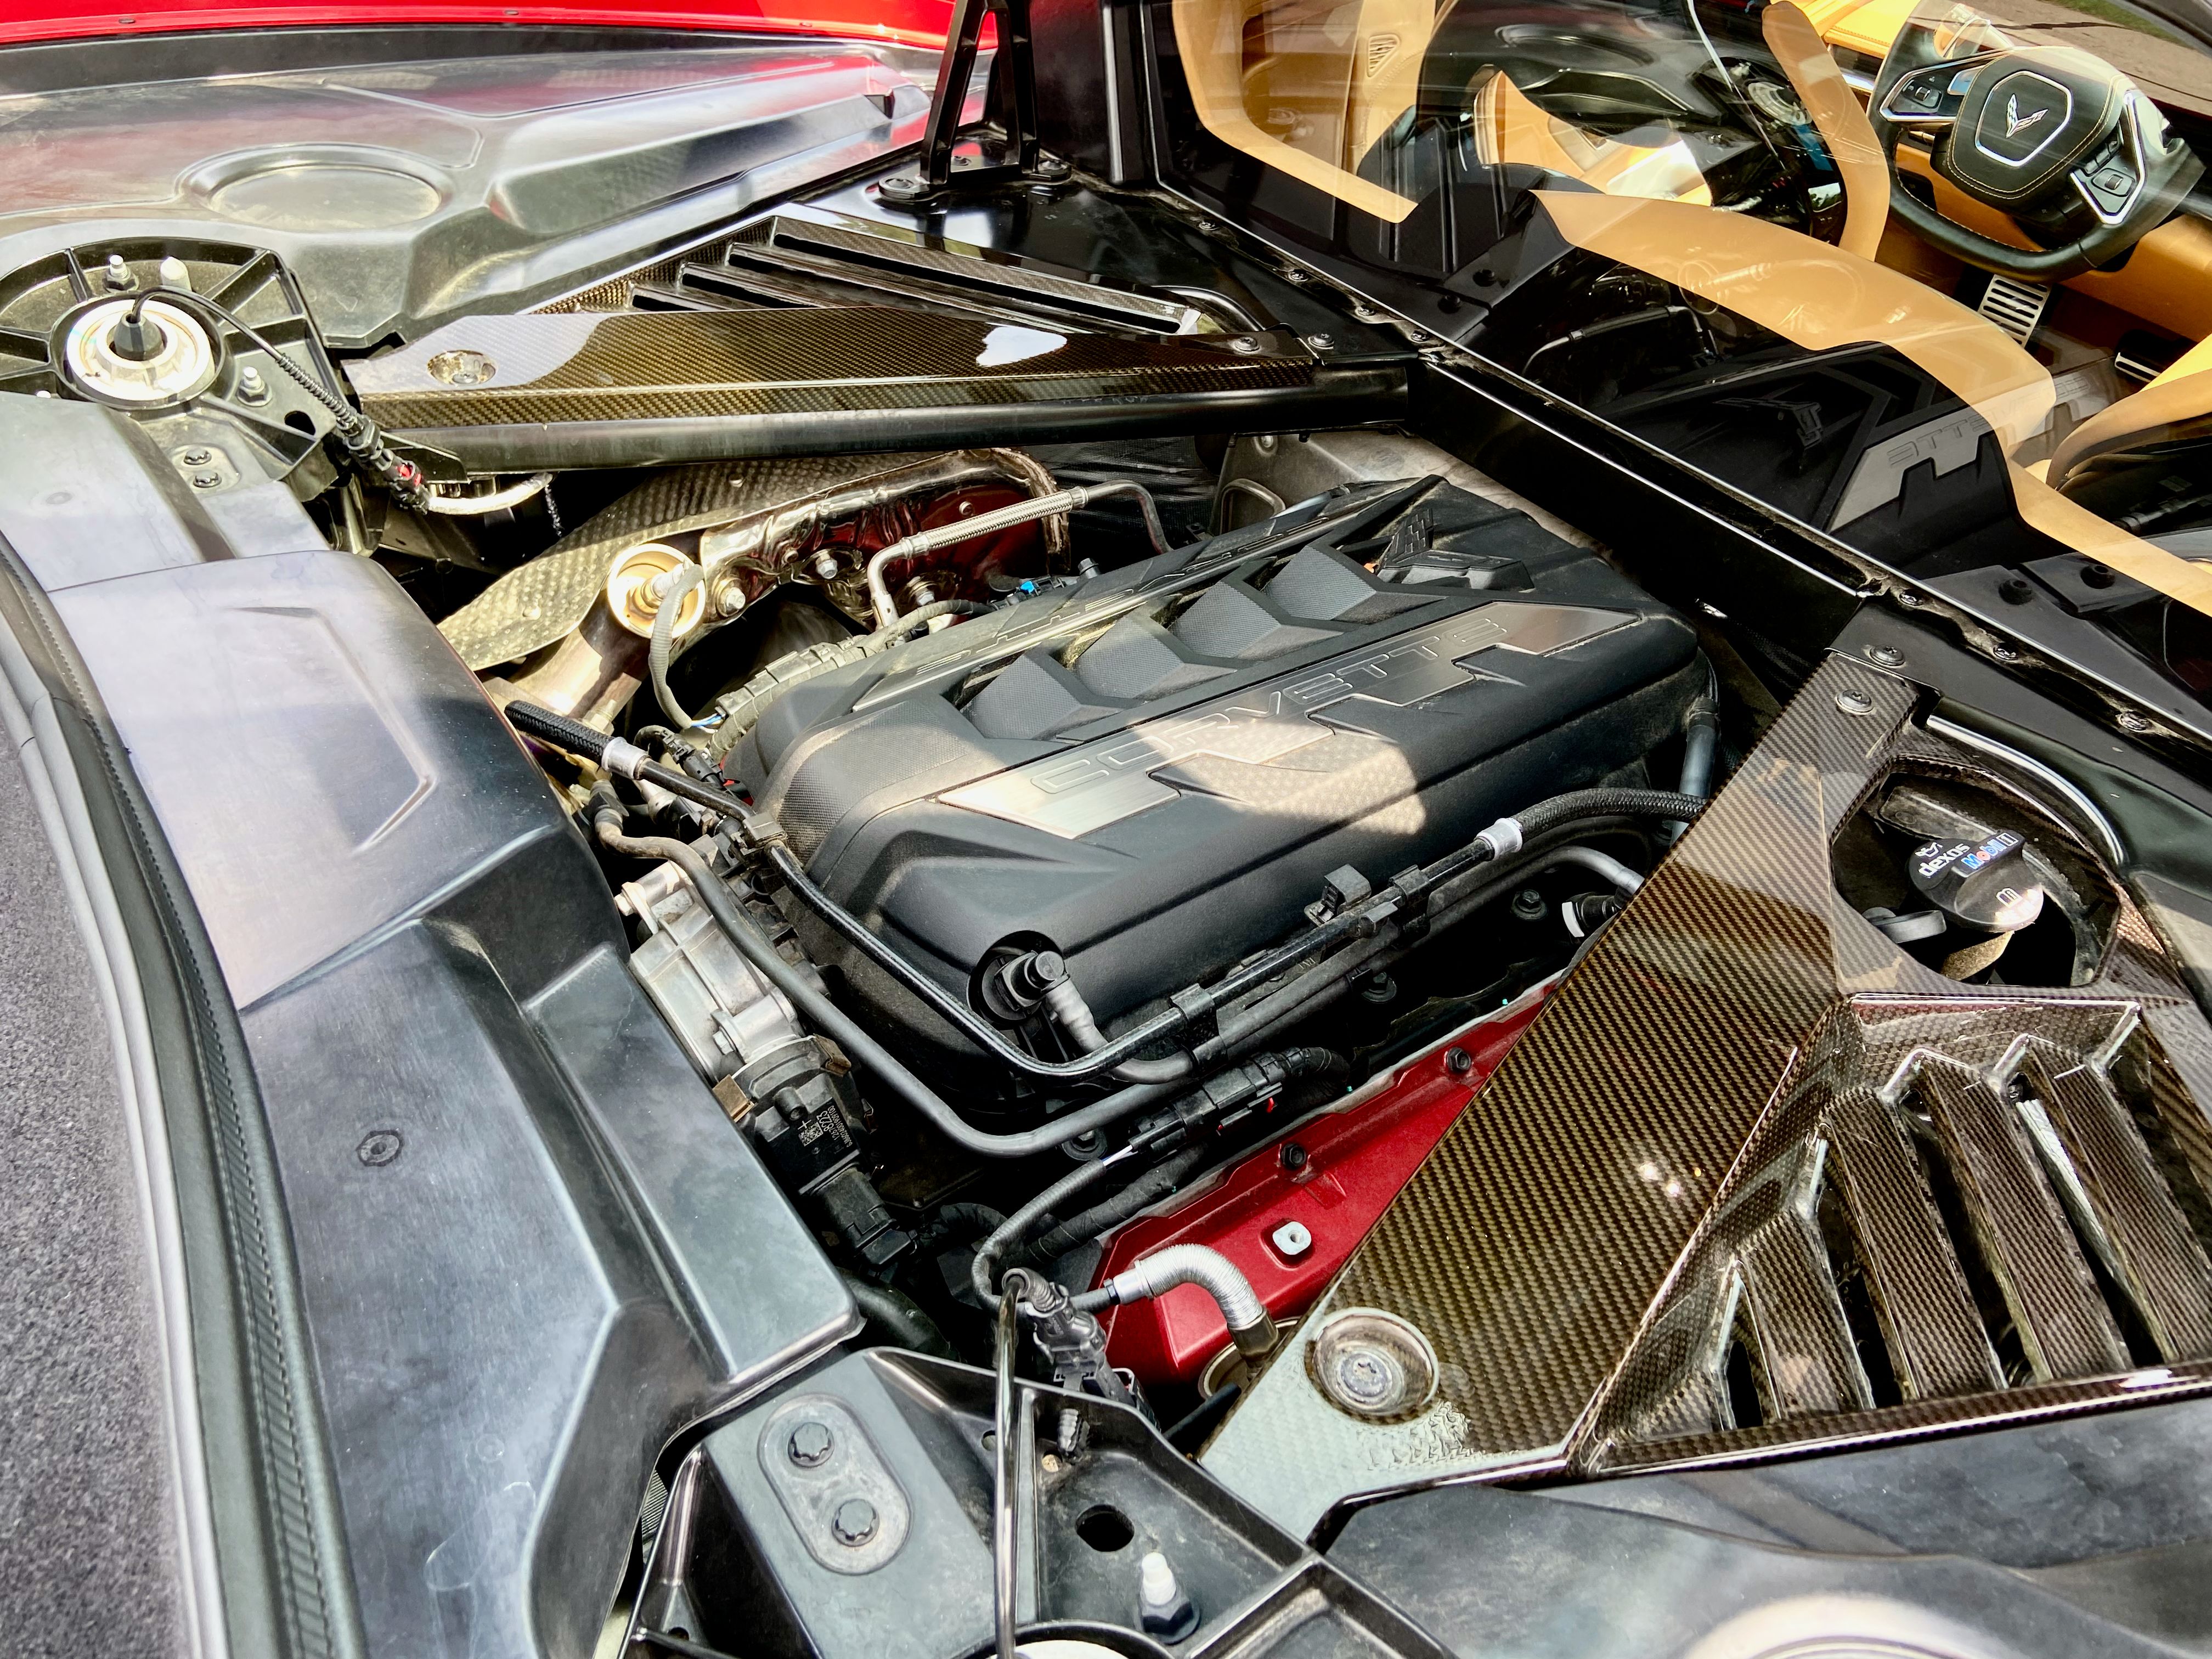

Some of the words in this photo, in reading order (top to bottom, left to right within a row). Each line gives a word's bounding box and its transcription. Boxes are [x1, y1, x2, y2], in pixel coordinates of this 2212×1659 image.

[1030, 617, 1508, 795] CORVETTE
[1918, 843, 1971, 878] dexos
[1961, 839, 2007, 870] Mobil
[816, 1110, 840, 1141] 12678223
